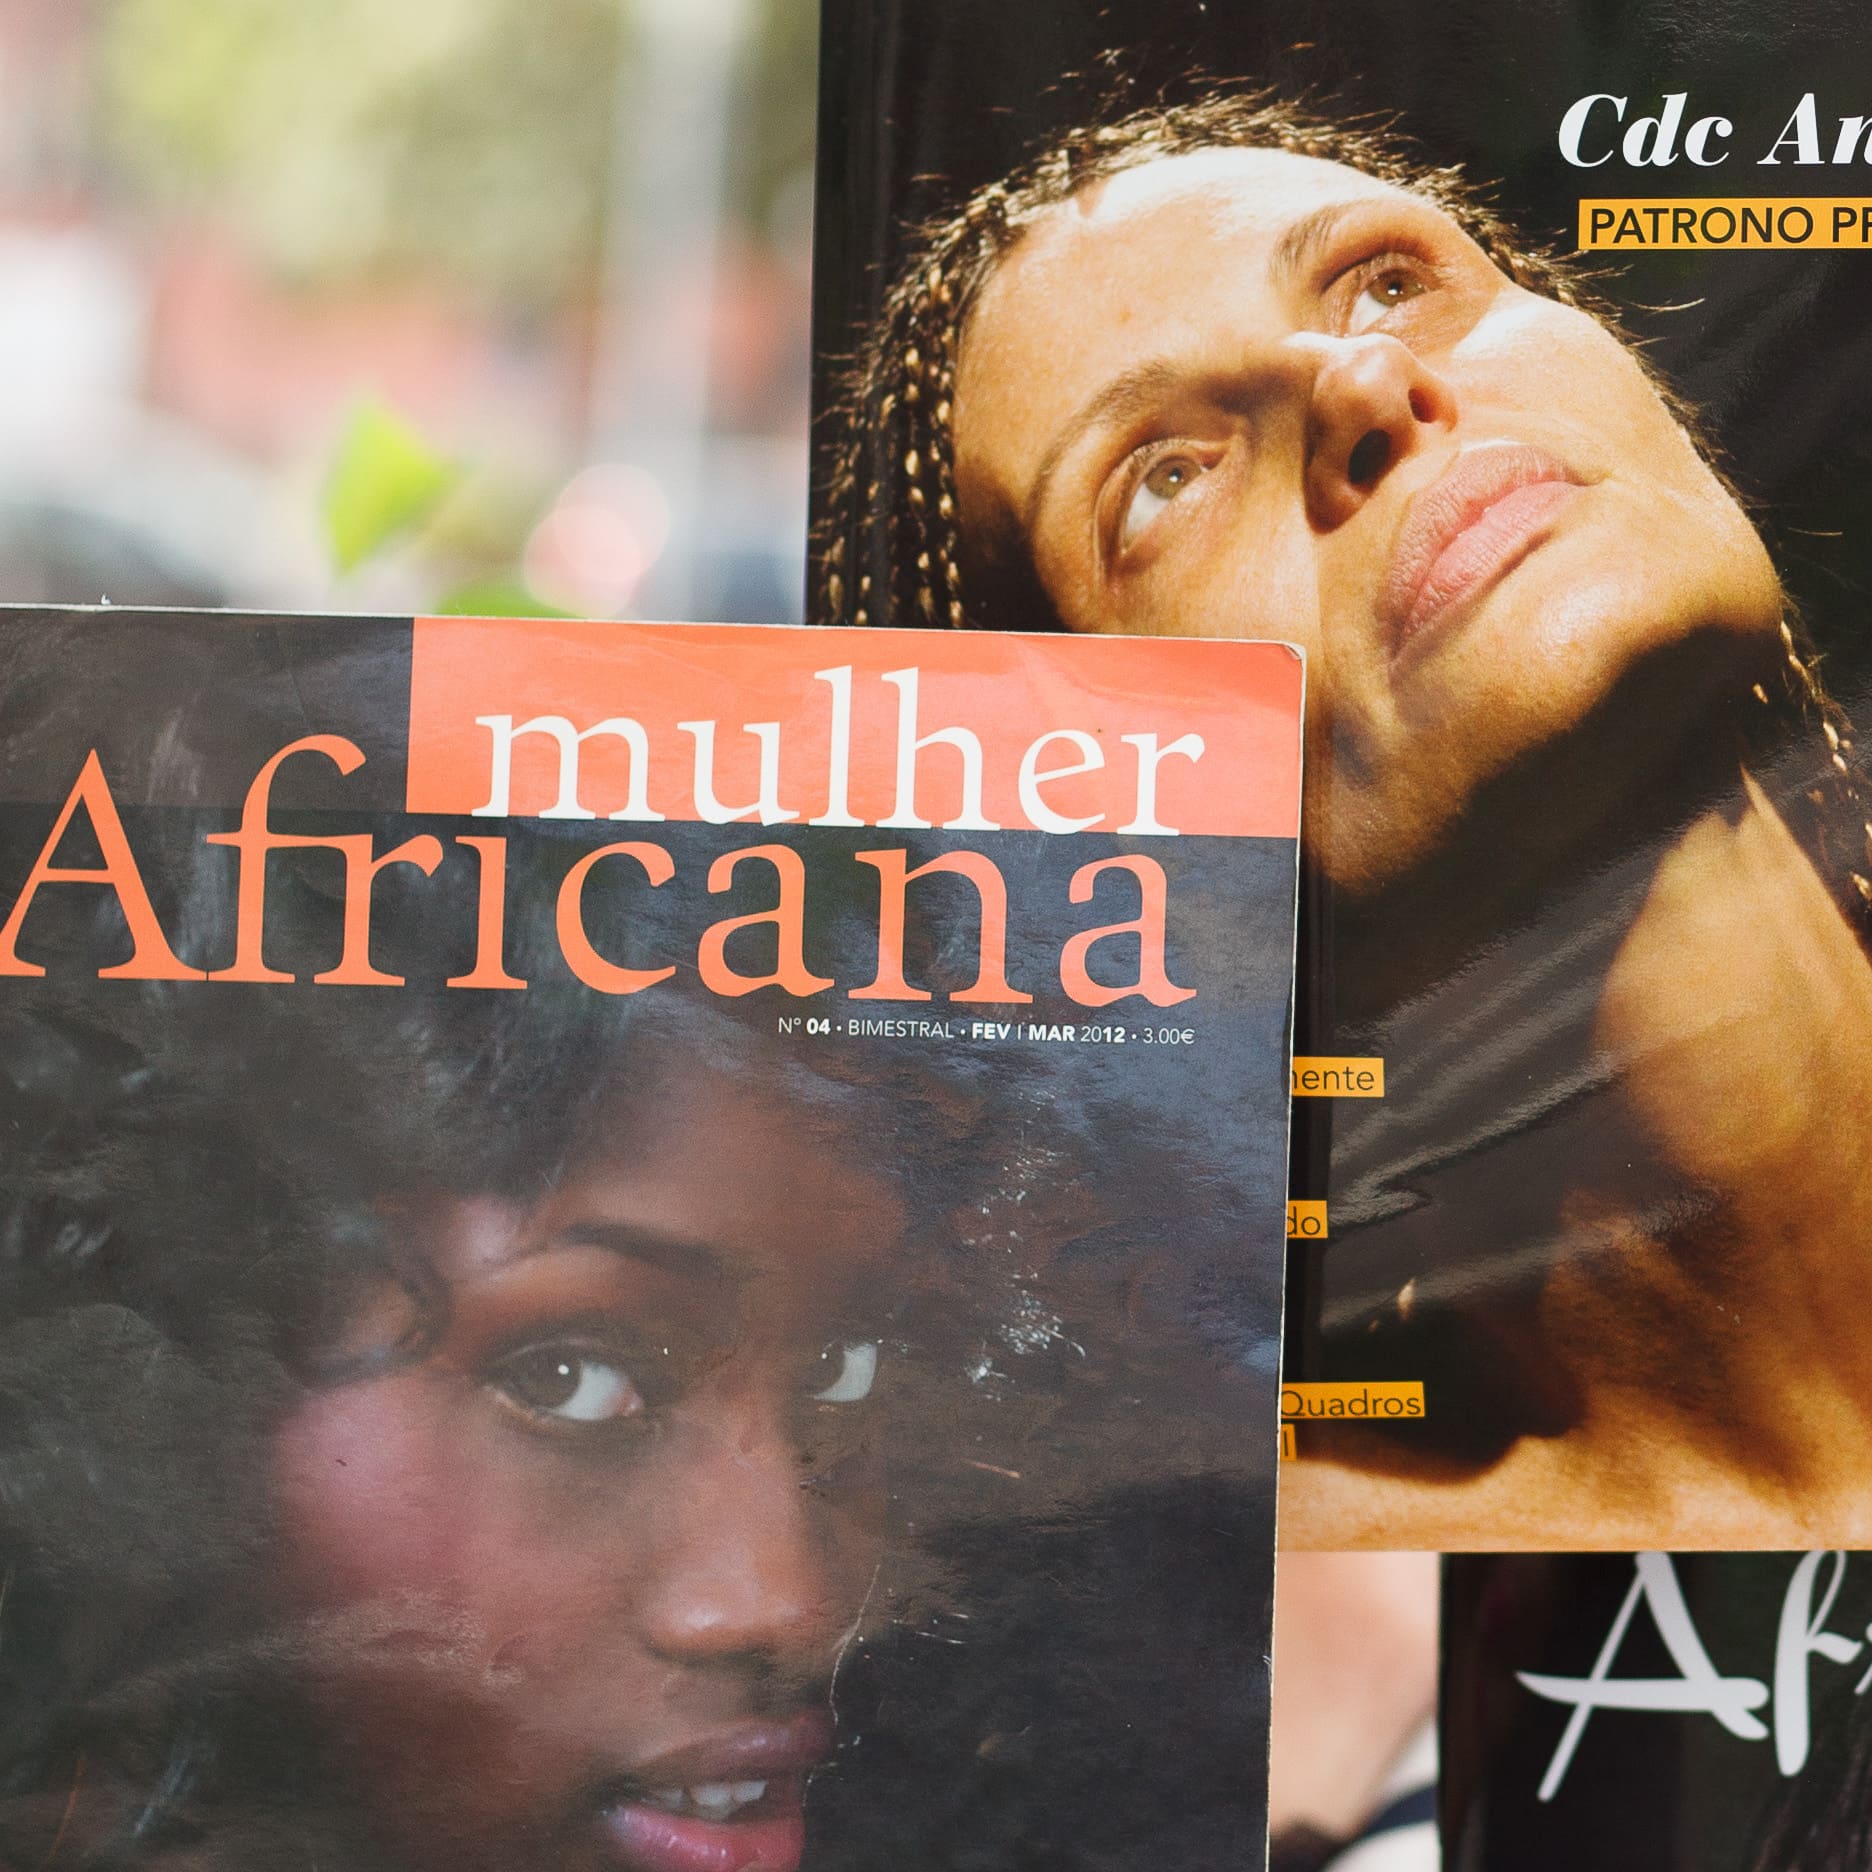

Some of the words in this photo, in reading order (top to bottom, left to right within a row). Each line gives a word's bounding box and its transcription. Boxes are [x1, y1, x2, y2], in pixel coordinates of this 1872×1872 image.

[1558, 92, 1733, 168] Cdc
[1590, 206, 1814, 244] PATRONO
[471, 665, 1206, 836] mulher
[0, 733, 1198, 1007] Africana
[806, 1017, 831, 1035] 04
[848, 1019, 954, 1039] BIMESTRAL
[972, 1022, 1011, 1040] FEV
[1028, 1024, 1076, 1042] MAR
[1080, 1025, 1126, 1043] 2012
[1143, 1027, 1195, 1045] 3.00€
[1292, 1062, 1376, 1092] ente
